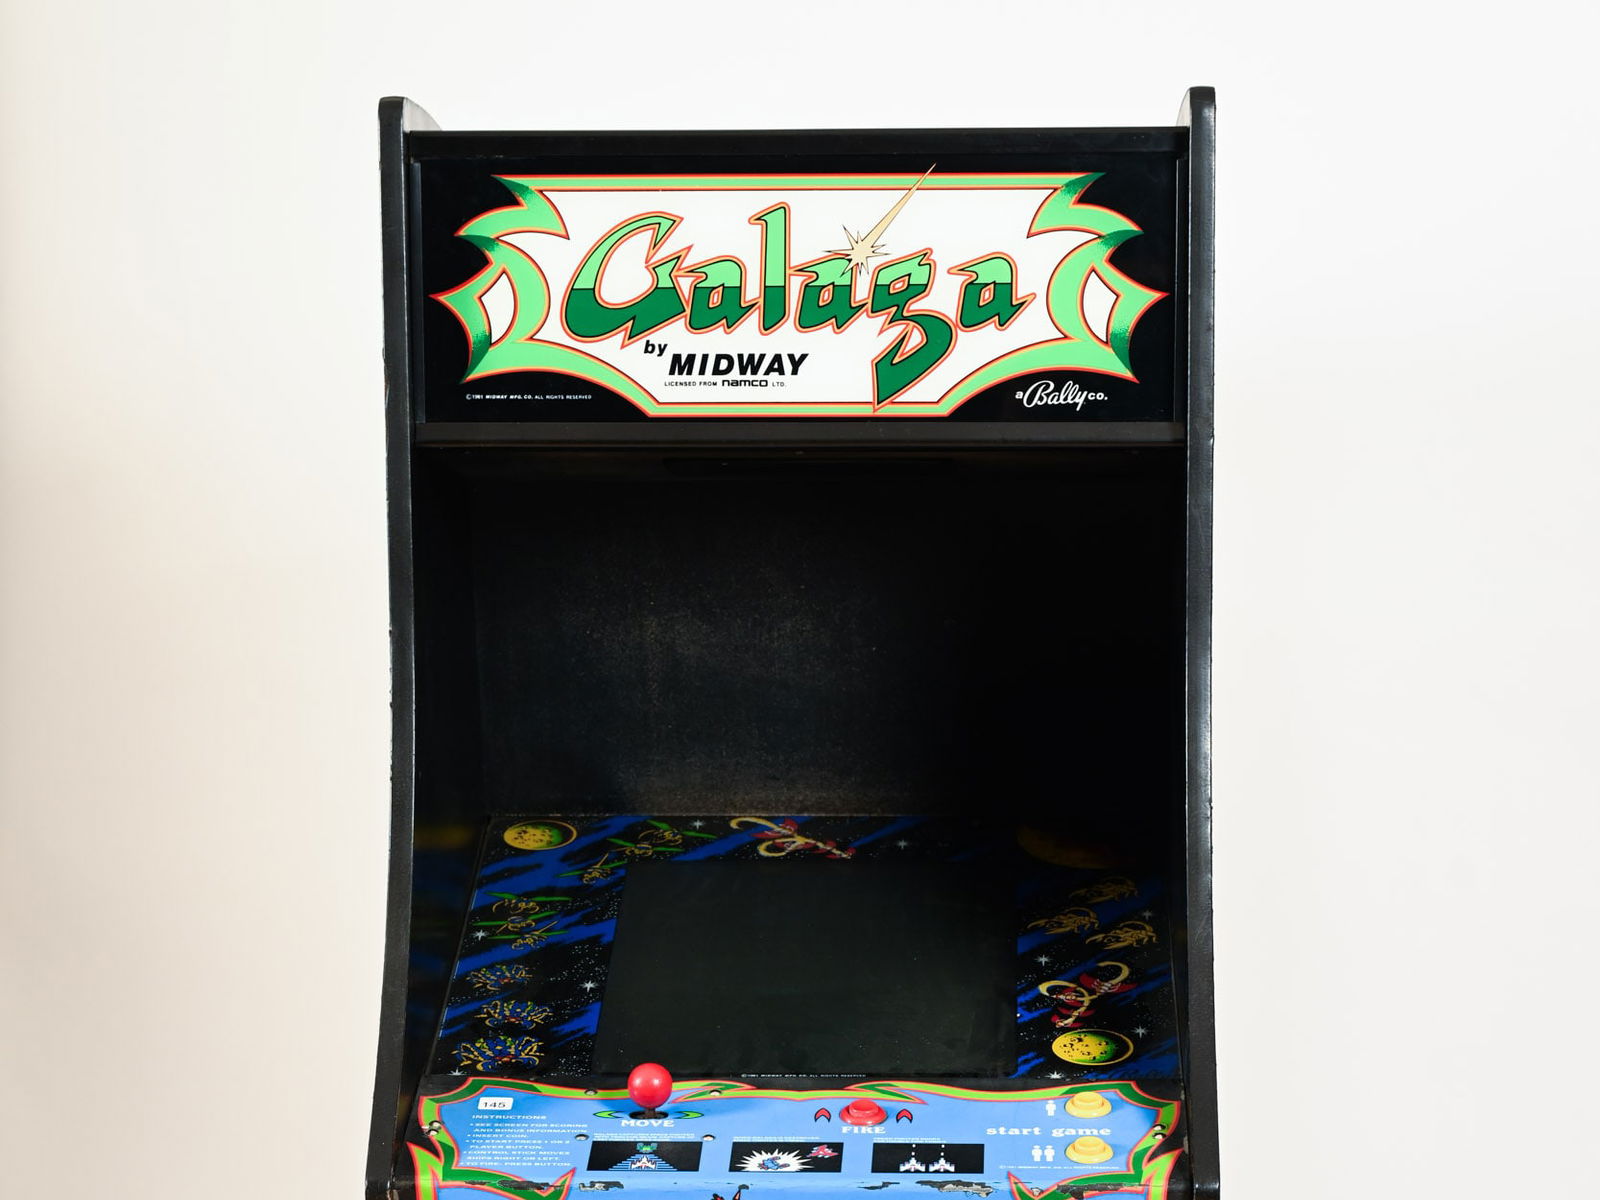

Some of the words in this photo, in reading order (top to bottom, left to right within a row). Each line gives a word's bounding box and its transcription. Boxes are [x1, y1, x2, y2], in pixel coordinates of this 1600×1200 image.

[560, 202, 1036, 412] Galaga
[643, 339, 668, 357] by
[668, 353, 809, 376] MIDWAY
[721, 379, 768, 387] namco
[1015, 391, 1024, 400] a
[1023, 380, 1088, 412] Bally
[1087, 392, 1108, 401] co.
[621, 1119, 674, 1127] MOVE
[842, 1126, 886, 1134] FIRE
[986, 1126, 1041, 1135] start
[1051, 1128, 1111, 1137] game
